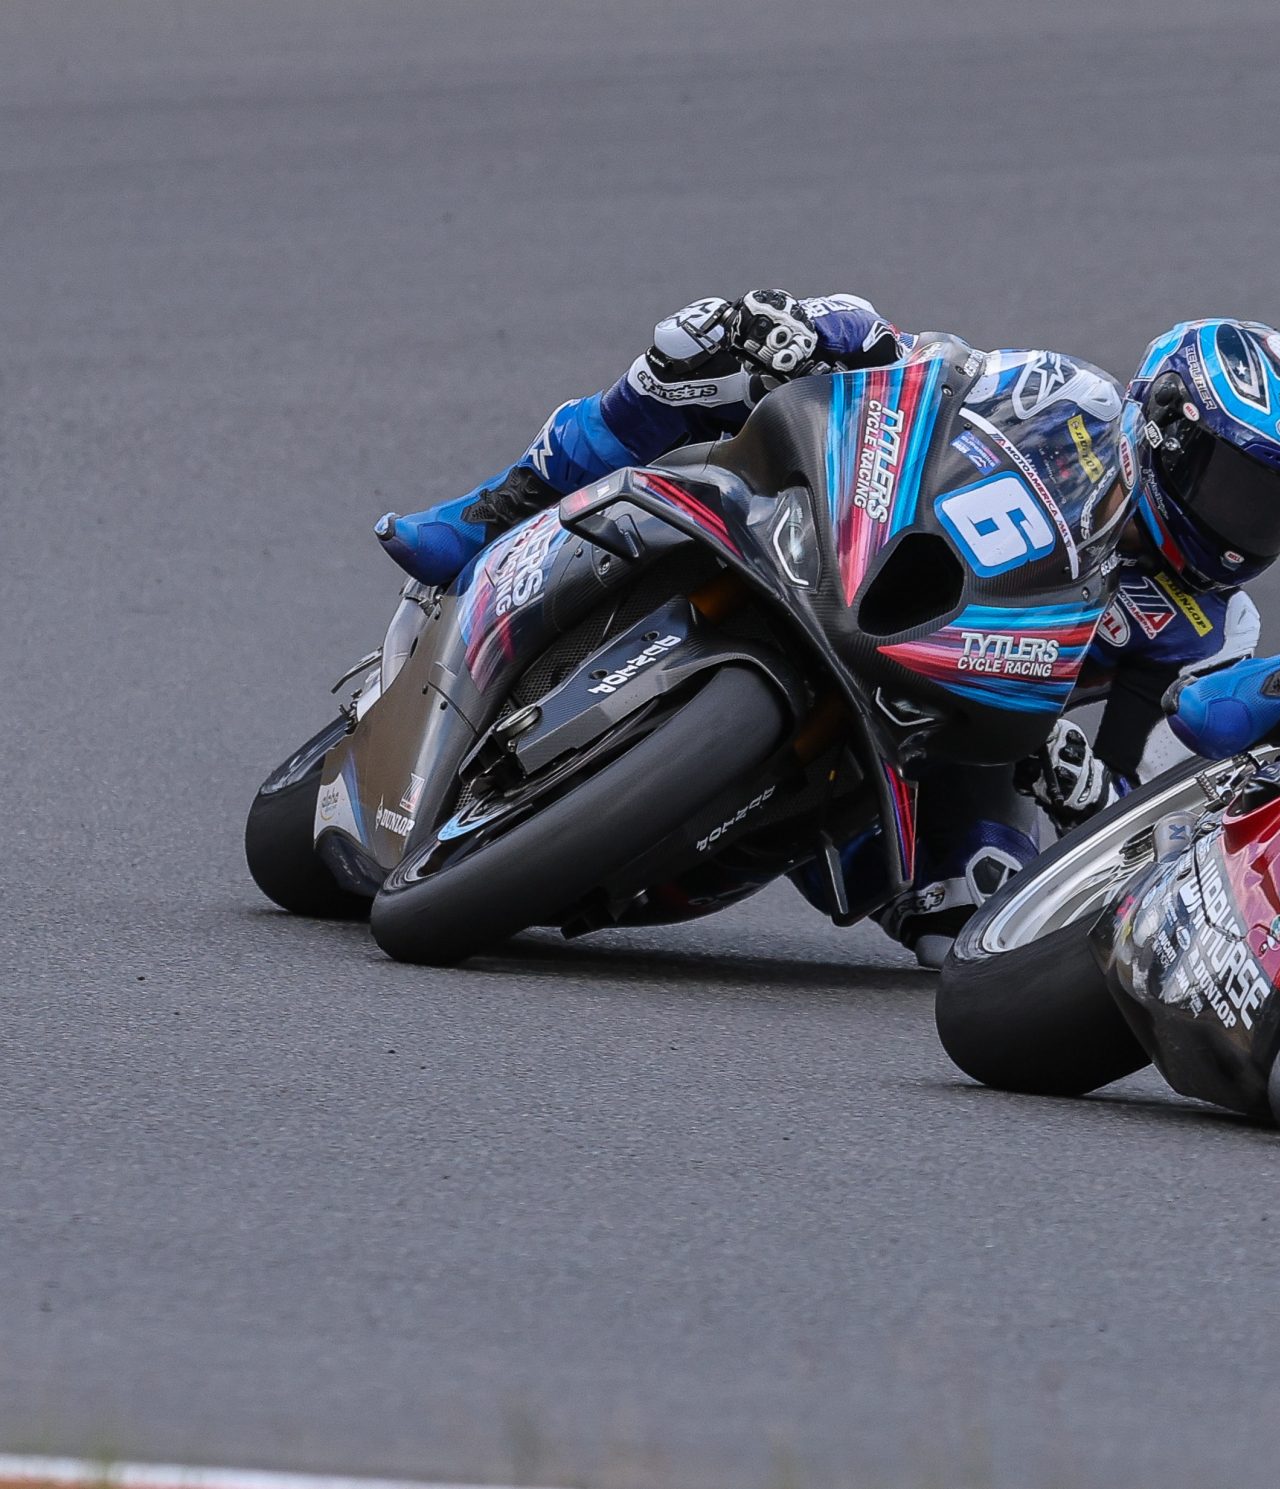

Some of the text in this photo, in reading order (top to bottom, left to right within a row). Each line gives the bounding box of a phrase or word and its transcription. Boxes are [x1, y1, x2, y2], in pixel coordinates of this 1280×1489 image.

[853, 399, 885, 510] CYCLE RACING
[867, 408, 906, 524] TYTLERS
[1003, 444, 1058, 518] MOTOAMERICA
[938, 474, 1056, 572] 6
[1169, 579, 1208, 630] DUNLOP
[958, 656, 1051, 678] CYCLE RACING
[961, 632, 1059, 664] TYTLERS
[380, 808, 416, 837] DUNLOP
[1193, 959, 1237, 1029] DUNLOP
